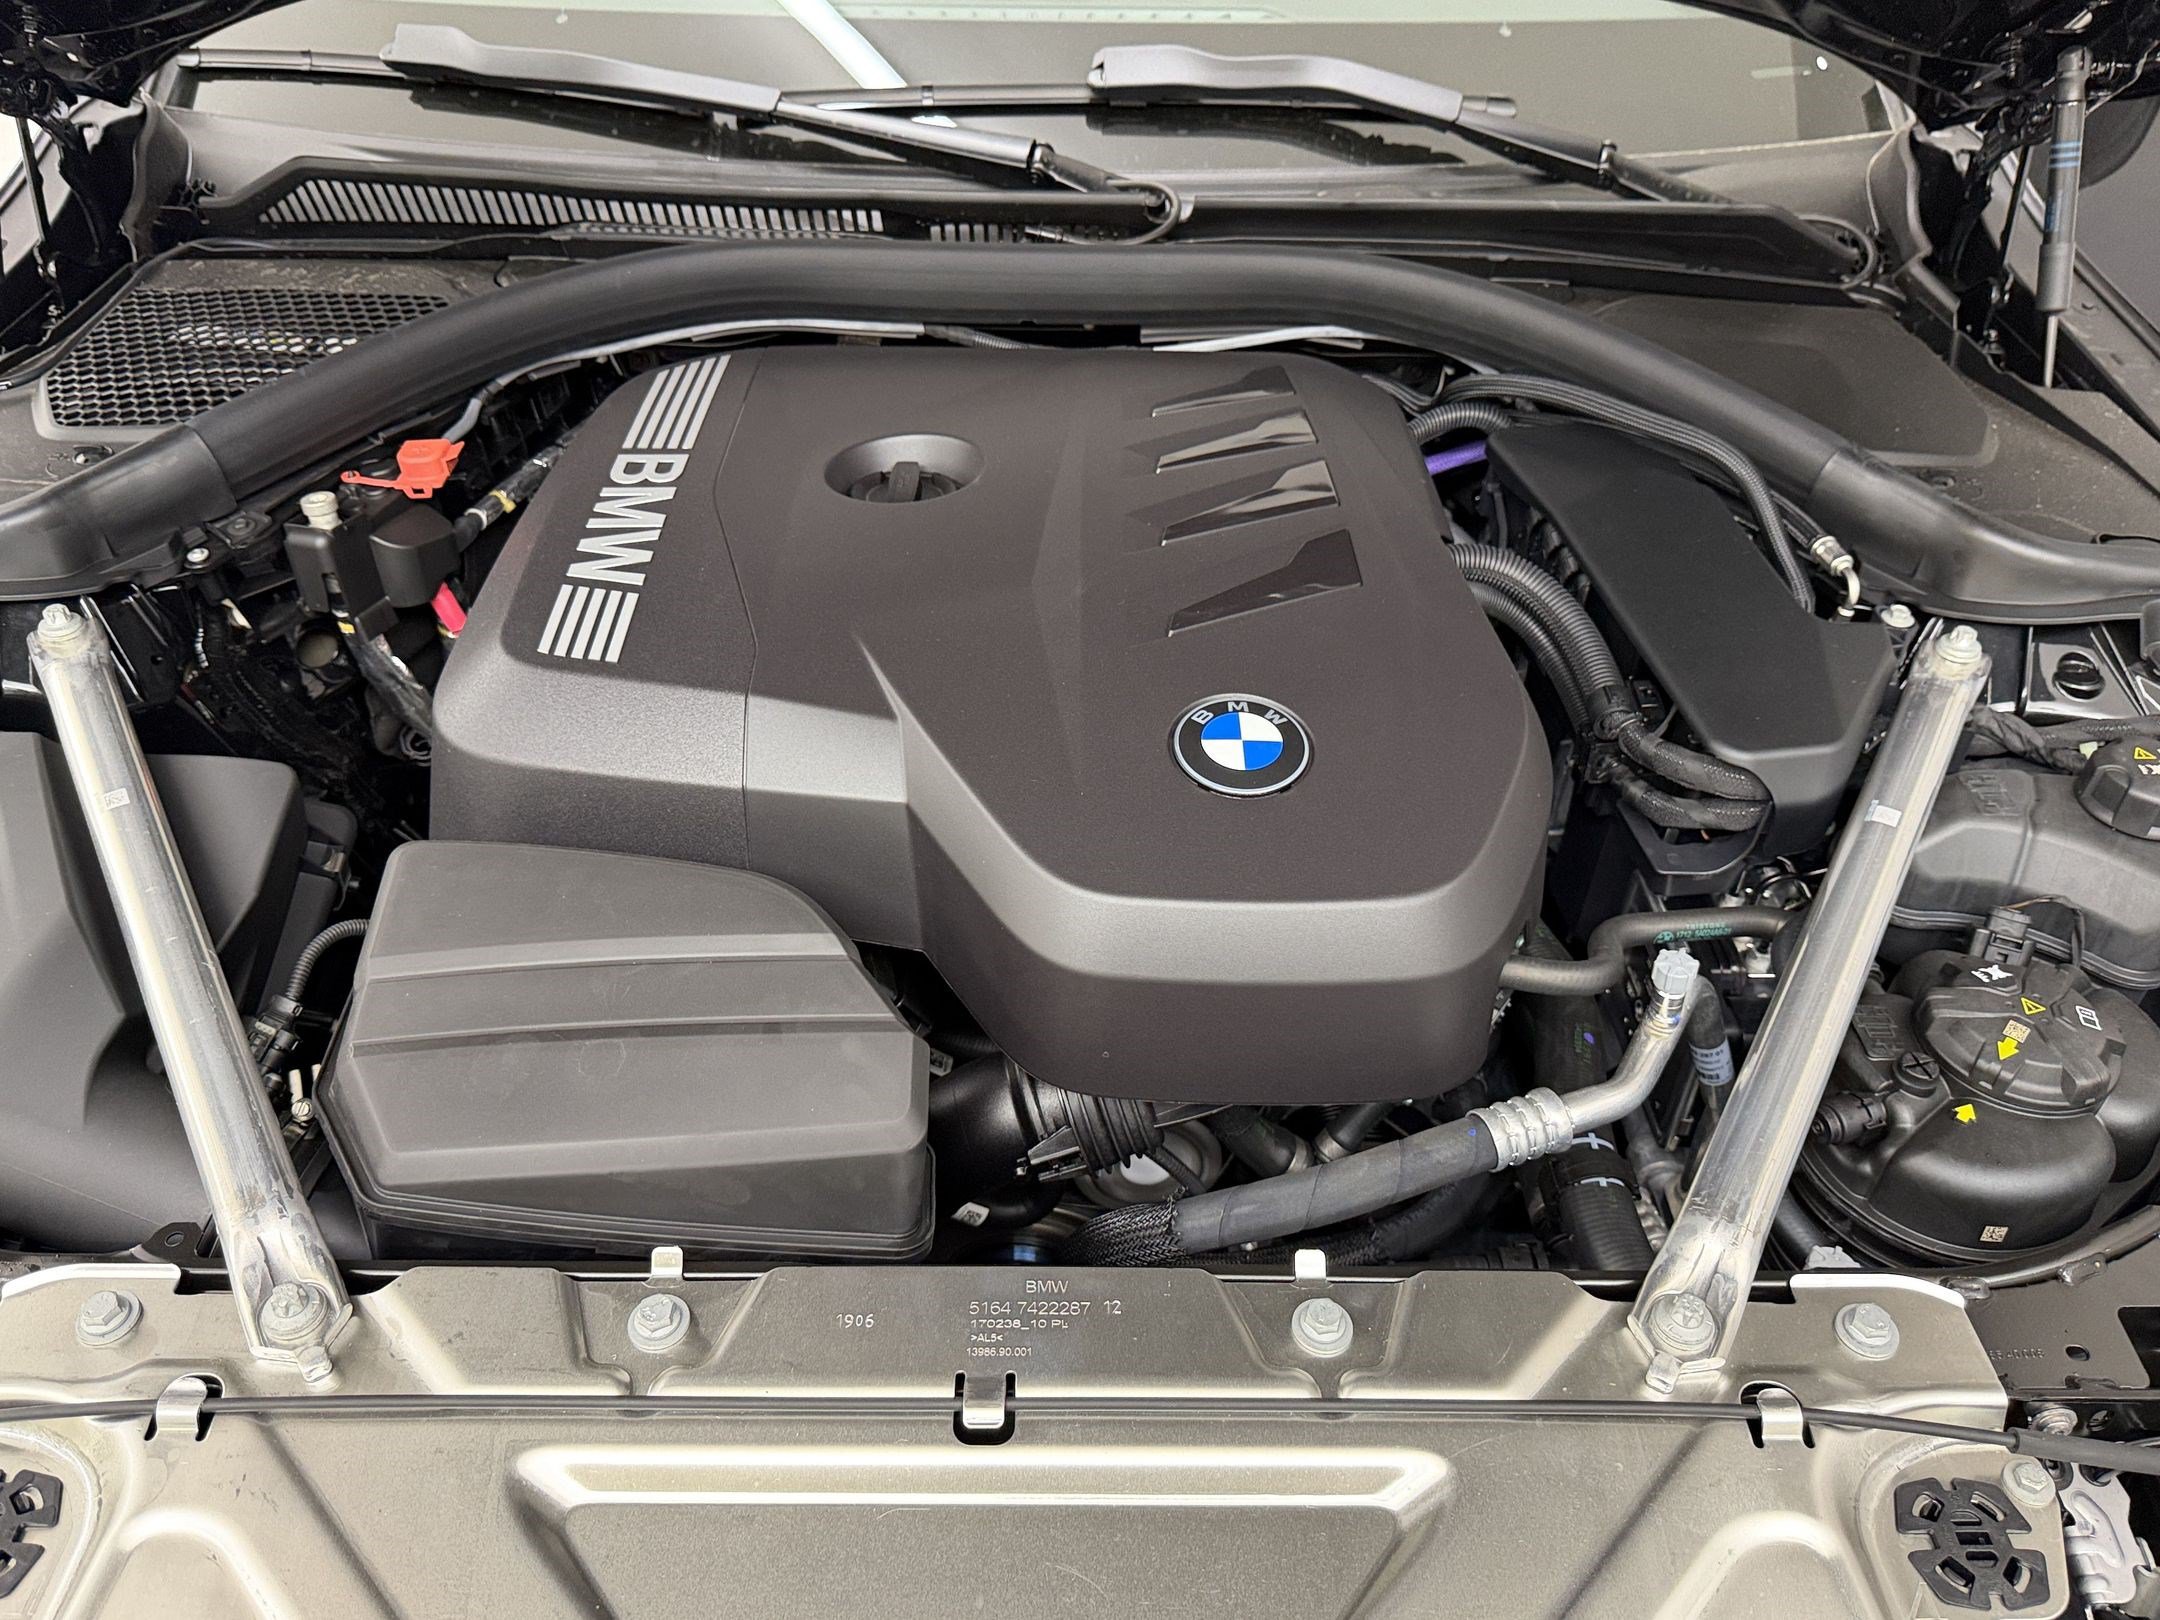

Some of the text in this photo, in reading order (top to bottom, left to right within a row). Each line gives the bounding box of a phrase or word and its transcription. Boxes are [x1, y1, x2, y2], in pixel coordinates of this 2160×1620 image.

[566, 453, 690, 586] BMW
[1190, 701, 1289, 725] BMW
[1025, 1280, 1069, 1293] BMW
[969, 1300, 1122, 1315] 5164 7422287 12
[836, 1313, 874, 1329] 1906
